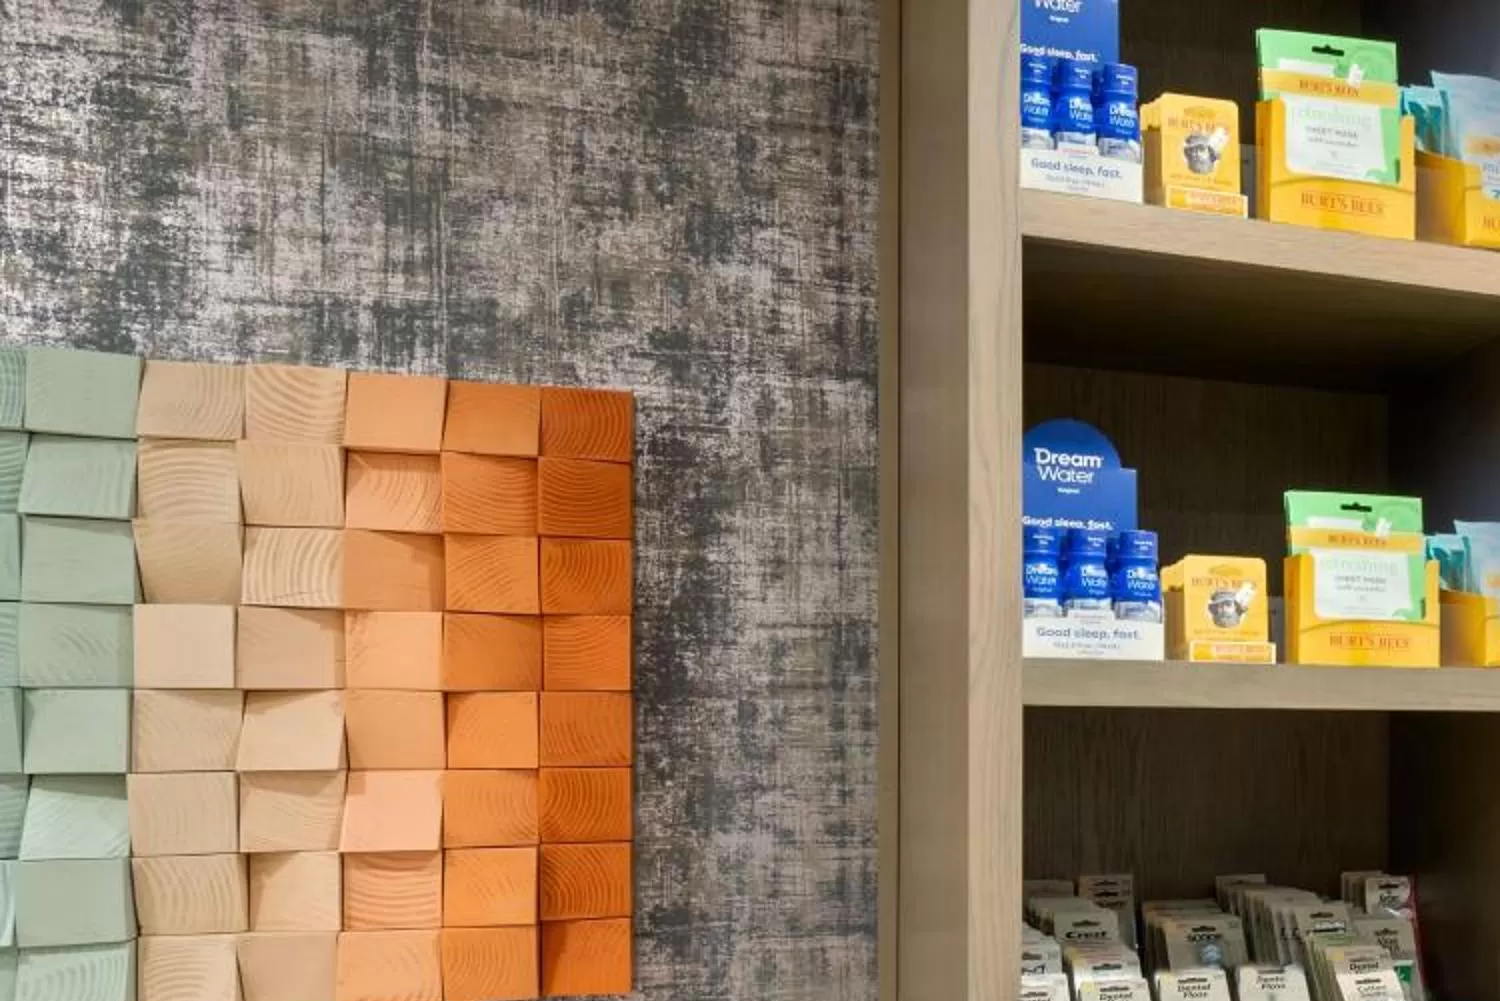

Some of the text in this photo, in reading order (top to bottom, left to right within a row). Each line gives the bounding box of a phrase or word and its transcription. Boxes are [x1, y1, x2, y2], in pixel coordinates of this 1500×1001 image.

[1031, 158, 1123, 179] Good sleep. fast.
[1301, 193, 1385, 214] BURT'S BEES
[1033, 446, 1103, 469] Dream
[1036, 465, 1094, 484] Water
[1036, 627, 1071, 638] Good
[1073, 628, 1111, 641] sleep.
[1065, 931, 1108, 941] Crest
[1177, 983, 1211, 993] Dental
